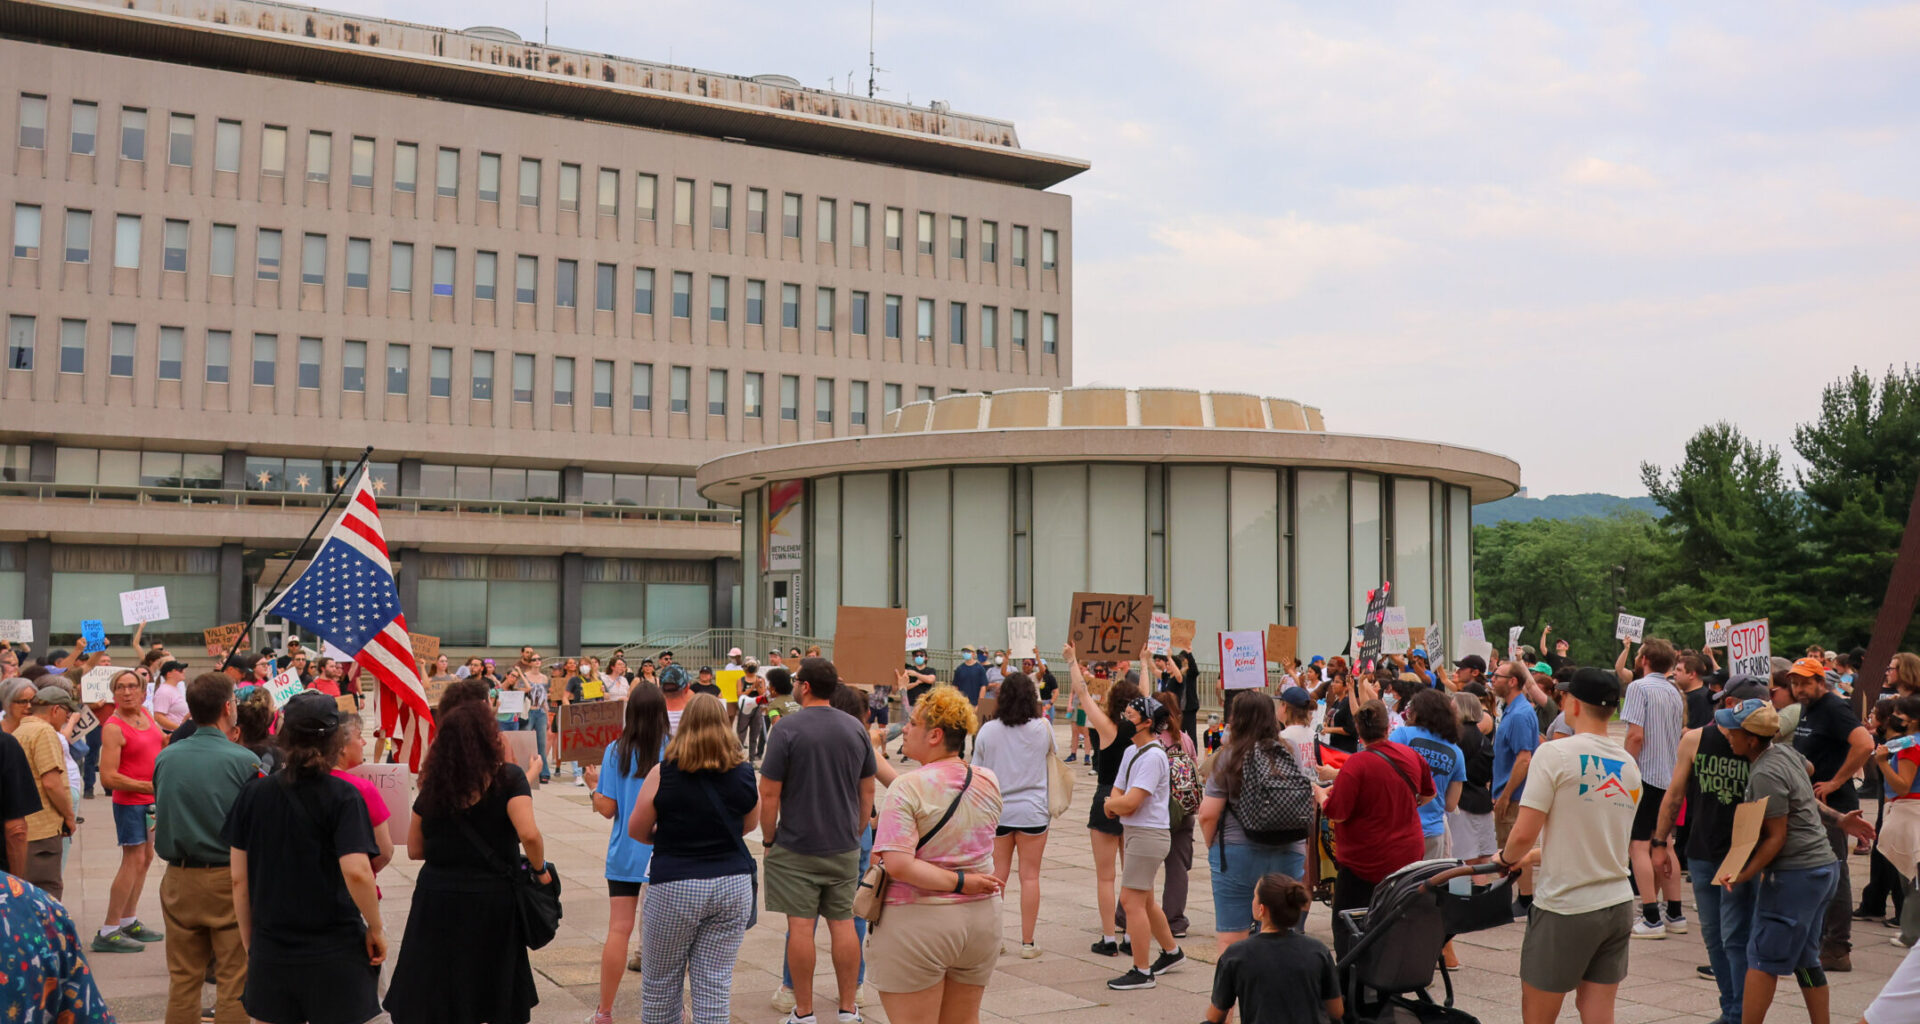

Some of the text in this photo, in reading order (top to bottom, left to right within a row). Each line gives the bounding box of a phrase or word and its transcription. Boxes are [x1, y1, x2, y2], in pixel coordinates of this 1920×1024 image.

[771, 544, 801, 552] BETHLEHEM
[788, 552, 801, 560] HALL
[1080, 596, 1142, 624] FUCK
[908, 616, 921, 627] NO
[1010, 621, 1035, 640] FUCK
[1086, 626, 1133, 654] ICE
[1731, 624, 1765, 660] STOP
[1234, 657, 1256, 667] Kind
[1735, 656, 1769, 676] ICE RAIDS
[274, 673, 290, 688] NO
[275, 679, 303, 702] KINGS
